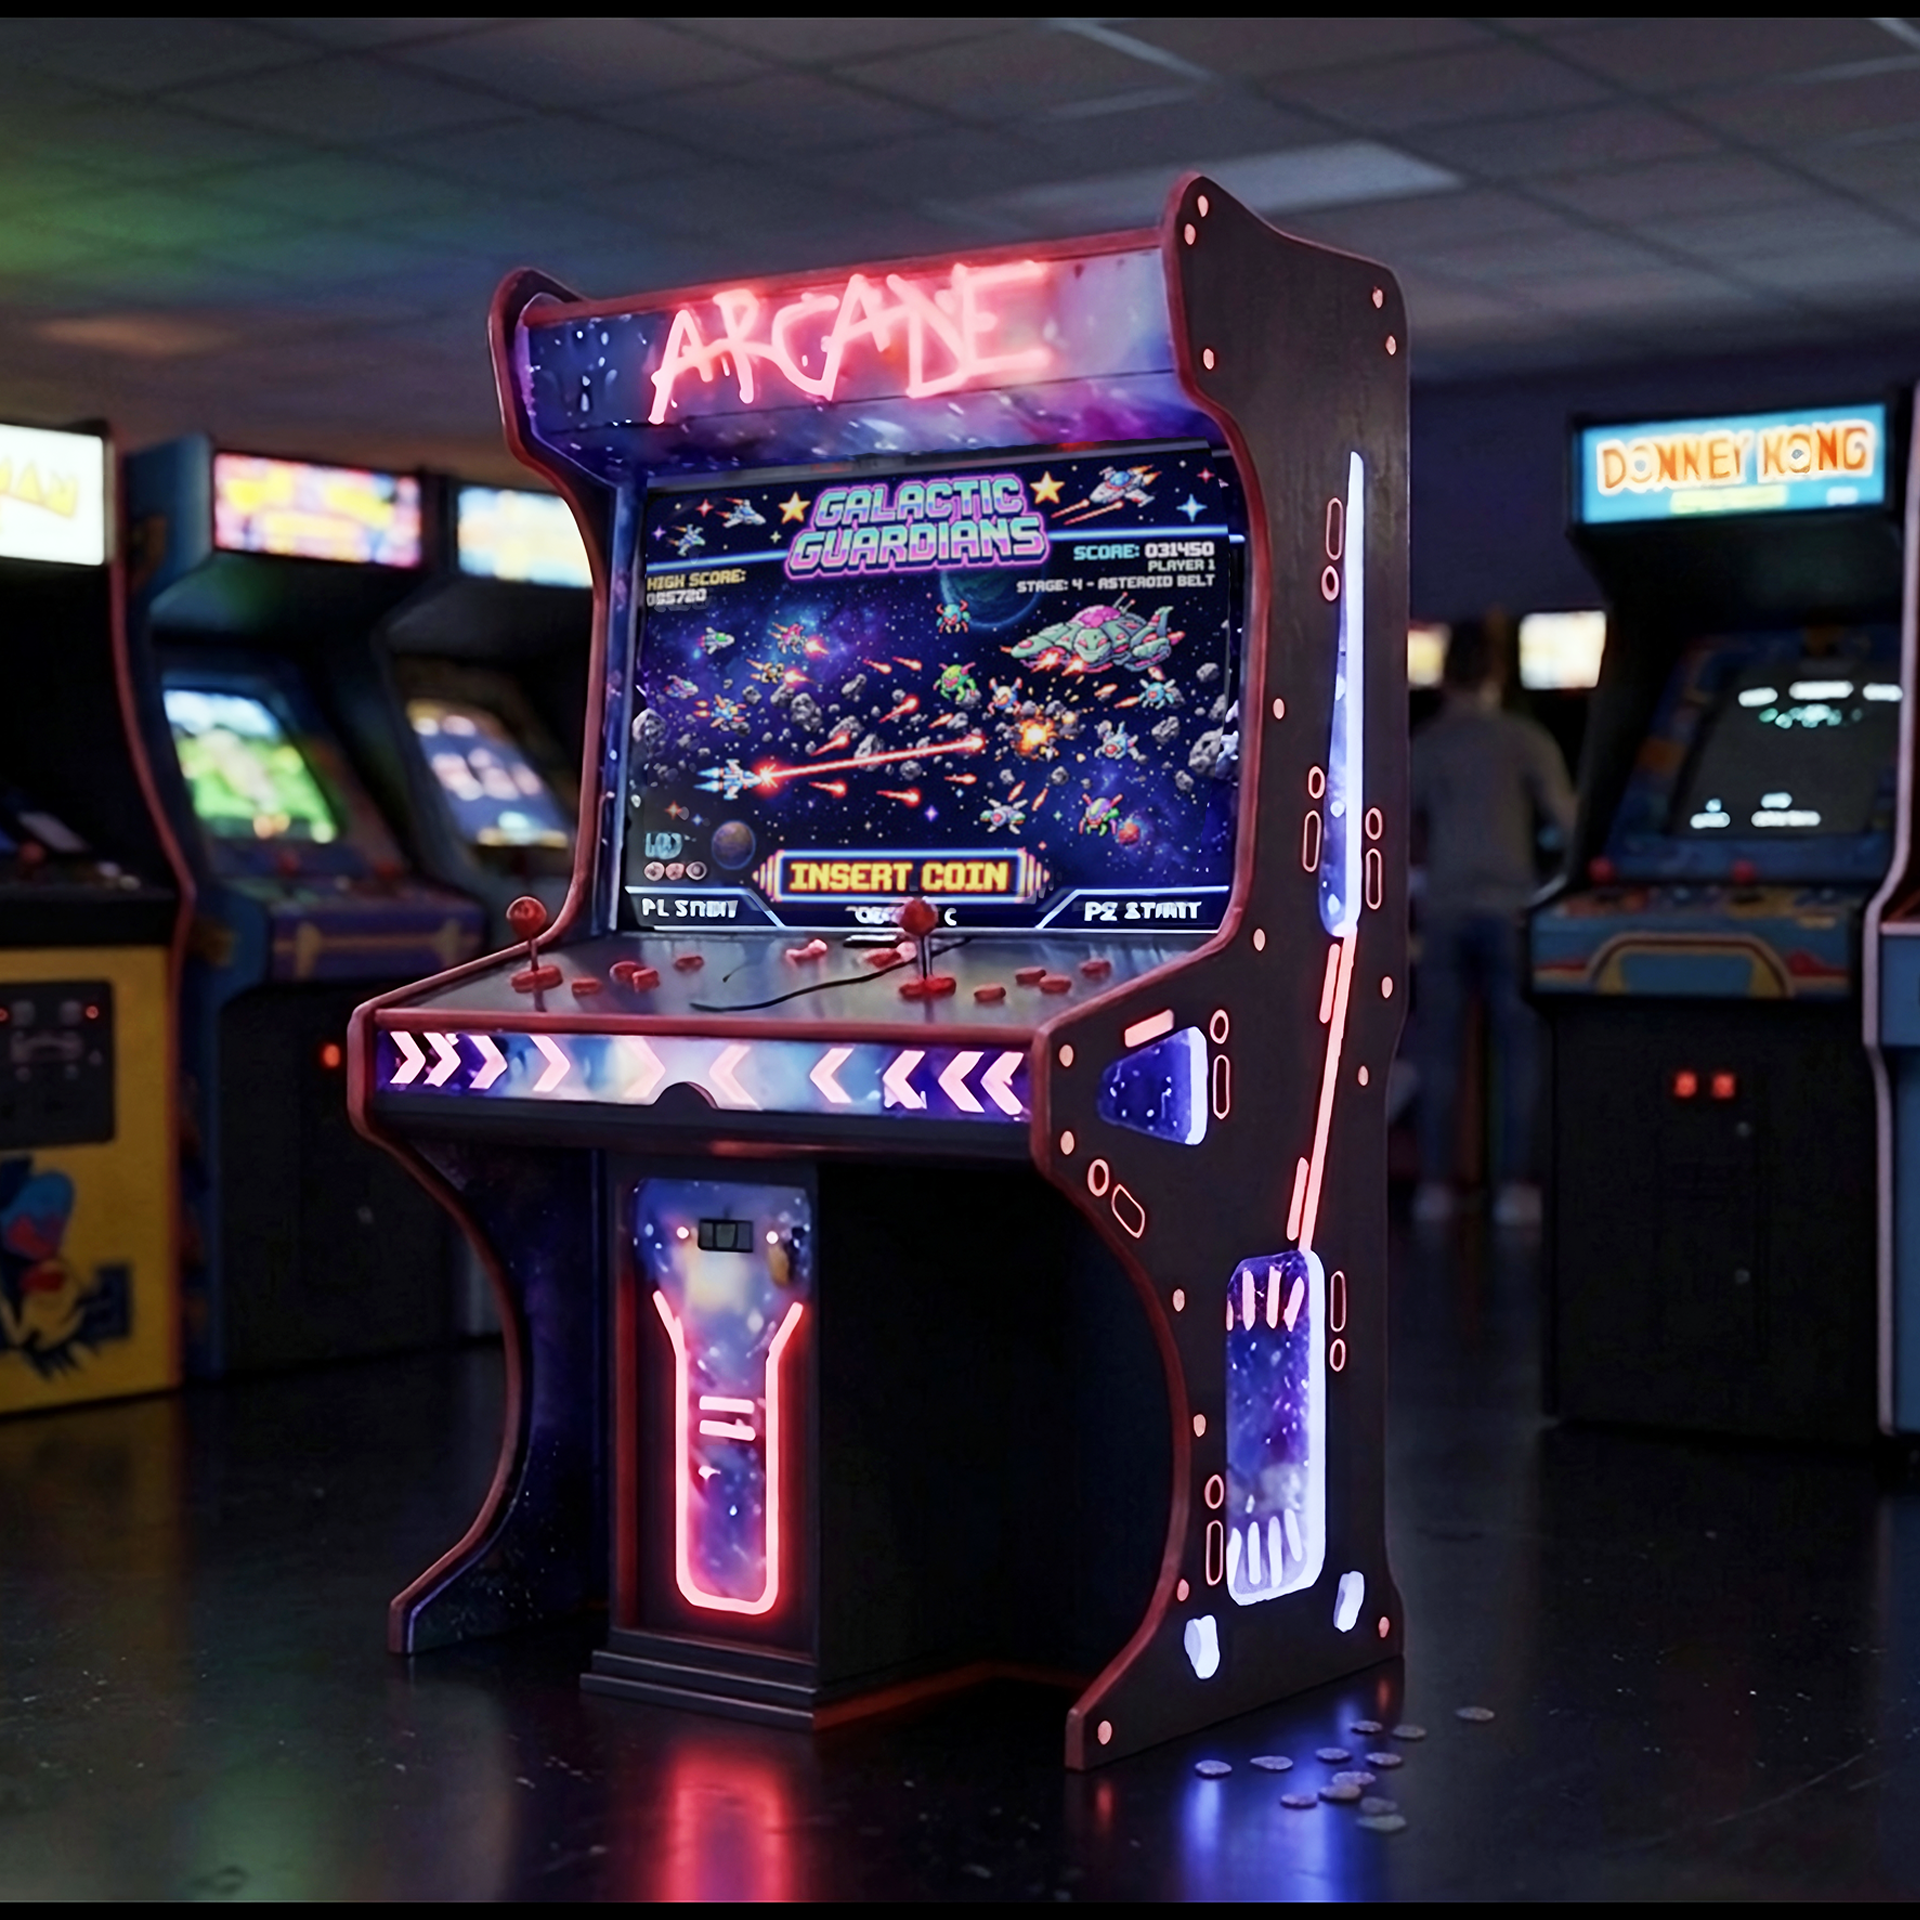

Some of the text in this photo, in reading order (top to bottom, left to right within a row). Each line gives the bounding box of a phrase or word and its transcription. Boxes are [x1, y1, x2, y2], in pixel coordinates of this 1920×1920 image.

[648, 262, 1050, 425] ARCADE
[1758, 419, 1876, 482] KONG
[815, 477, 1023, 527] GALACTIC
[788, 516, 1046, 570] GUARDIANS
[1073, 541, 1215, 561] SCORE: 031450
[646, 568, 747, 591] HIGH SCORE:
[1148, 559, 1216, 572] PLAYER 1
[1016, 579, 1069, 593] STAGE:
[1071, 578, 1083, 590] 4
[1098, 576, 1173, 590] ASTEROID
[1176, 574, 1216, 587] BELT
[789, 861, 1009, 892] INSERT COIN
